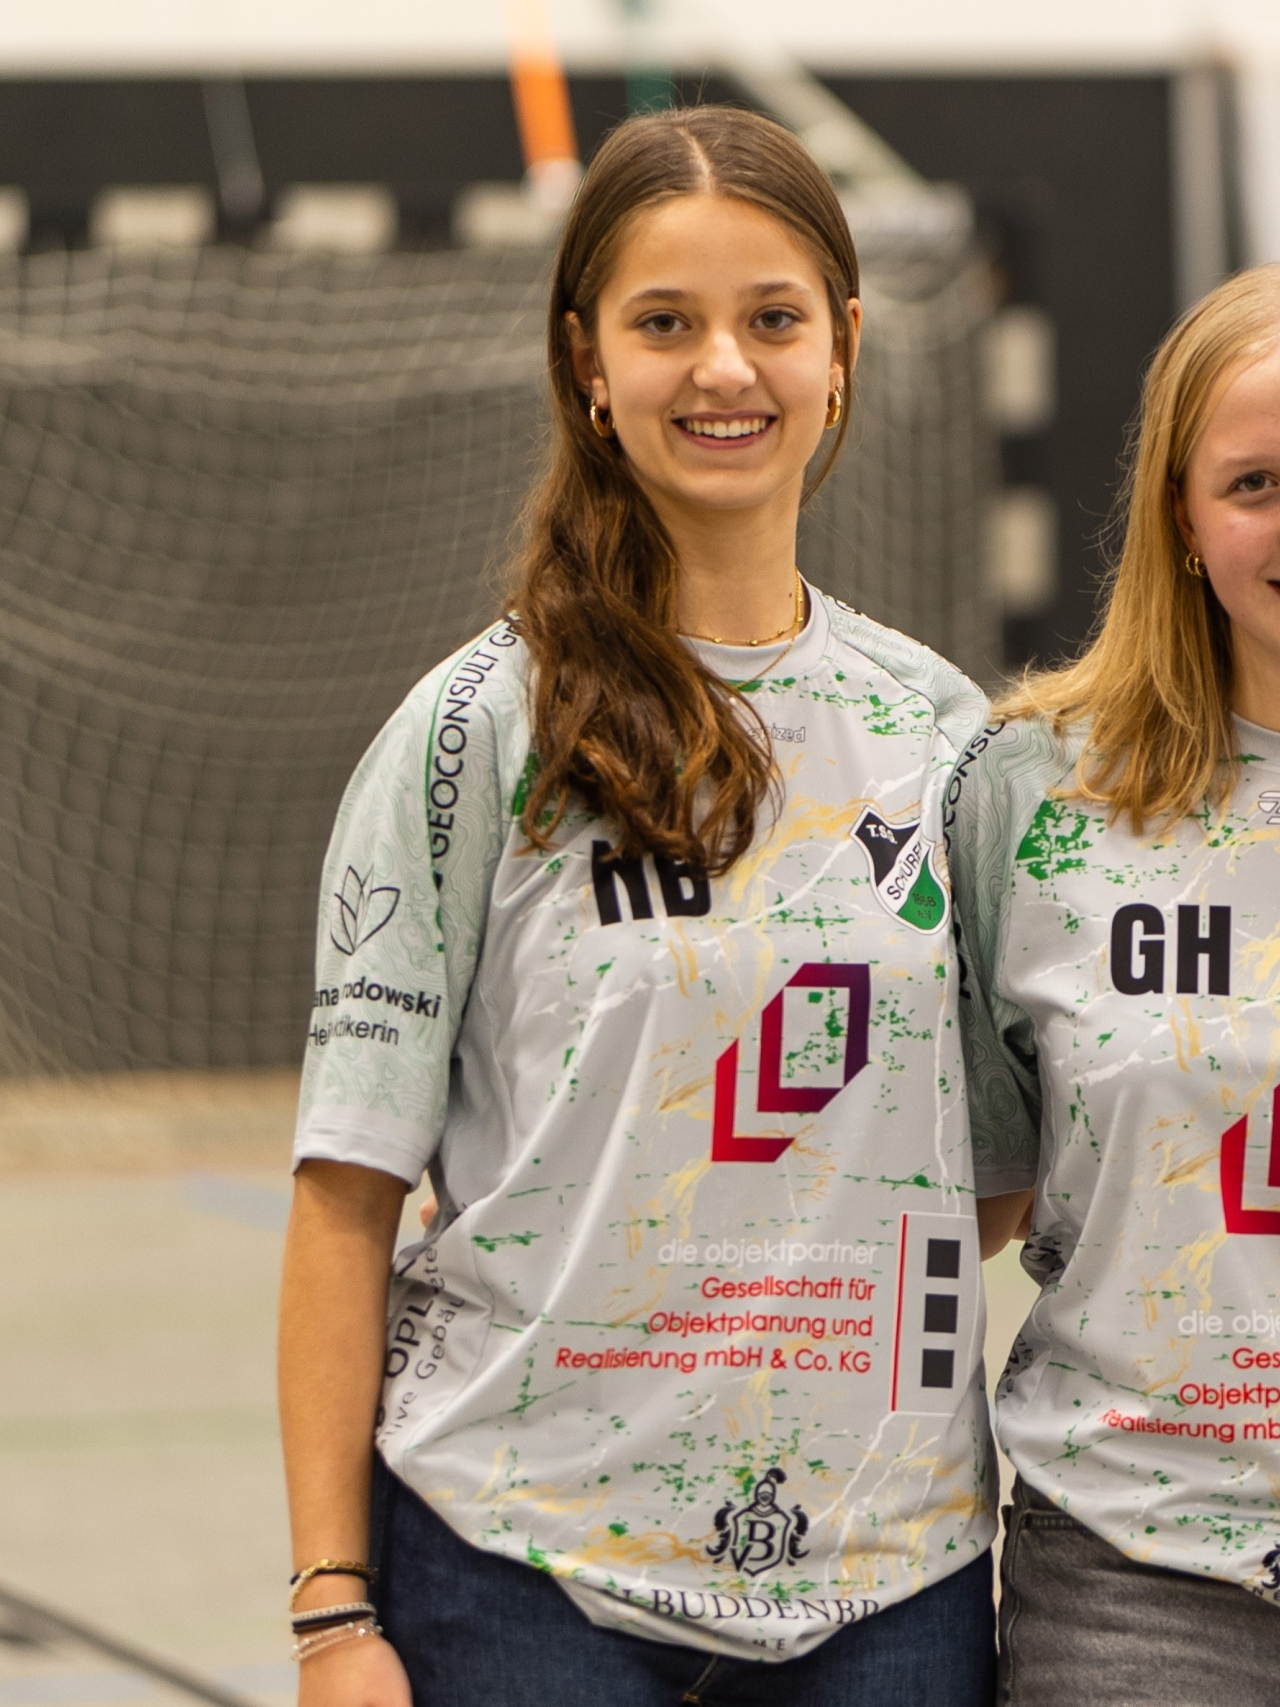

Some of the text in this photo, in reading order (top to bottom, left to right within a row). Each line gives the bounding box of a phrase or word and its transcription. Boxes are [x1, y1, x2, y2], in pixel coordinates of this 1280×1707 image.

[428, 650, 500, 859] GEOCONSULT
[1110, 903, 1232, 997] GH
[658, 1238, 879, 1268] die objektpartner
[701, 1276, 876, 1301] Gesellschaft für
[648, 1310, 872, 1338] Objektplanung und
[1178, 1310, 1227, 1335] die
[555, 1346, 872, 1374] Realisierung mbH & Co. KG
